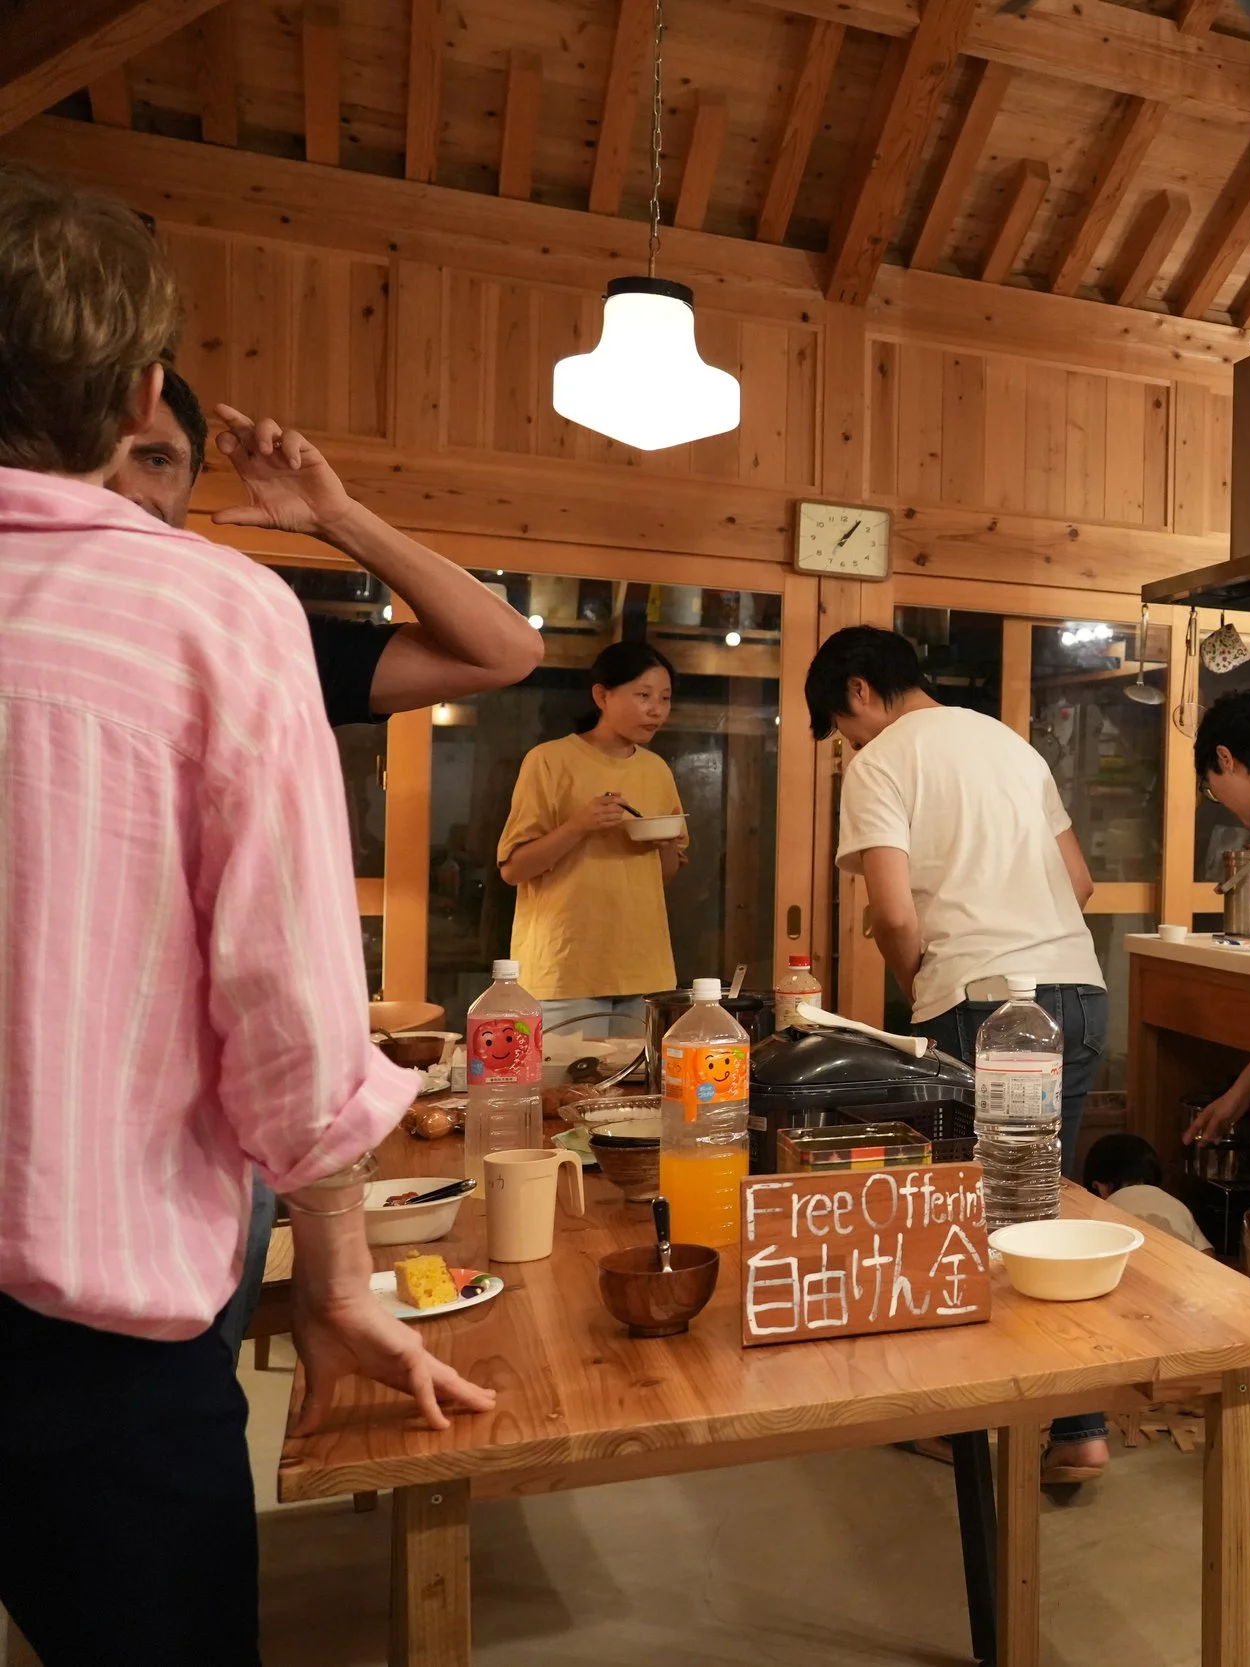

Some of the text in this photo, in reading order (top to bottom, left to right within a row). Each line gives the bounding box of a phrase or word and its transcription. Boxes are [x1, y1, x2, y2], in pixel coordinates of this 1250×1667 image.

[746, 1171, 987, 1241] Free Offering
[746, 1224, 986, 1336] 自由けん金
